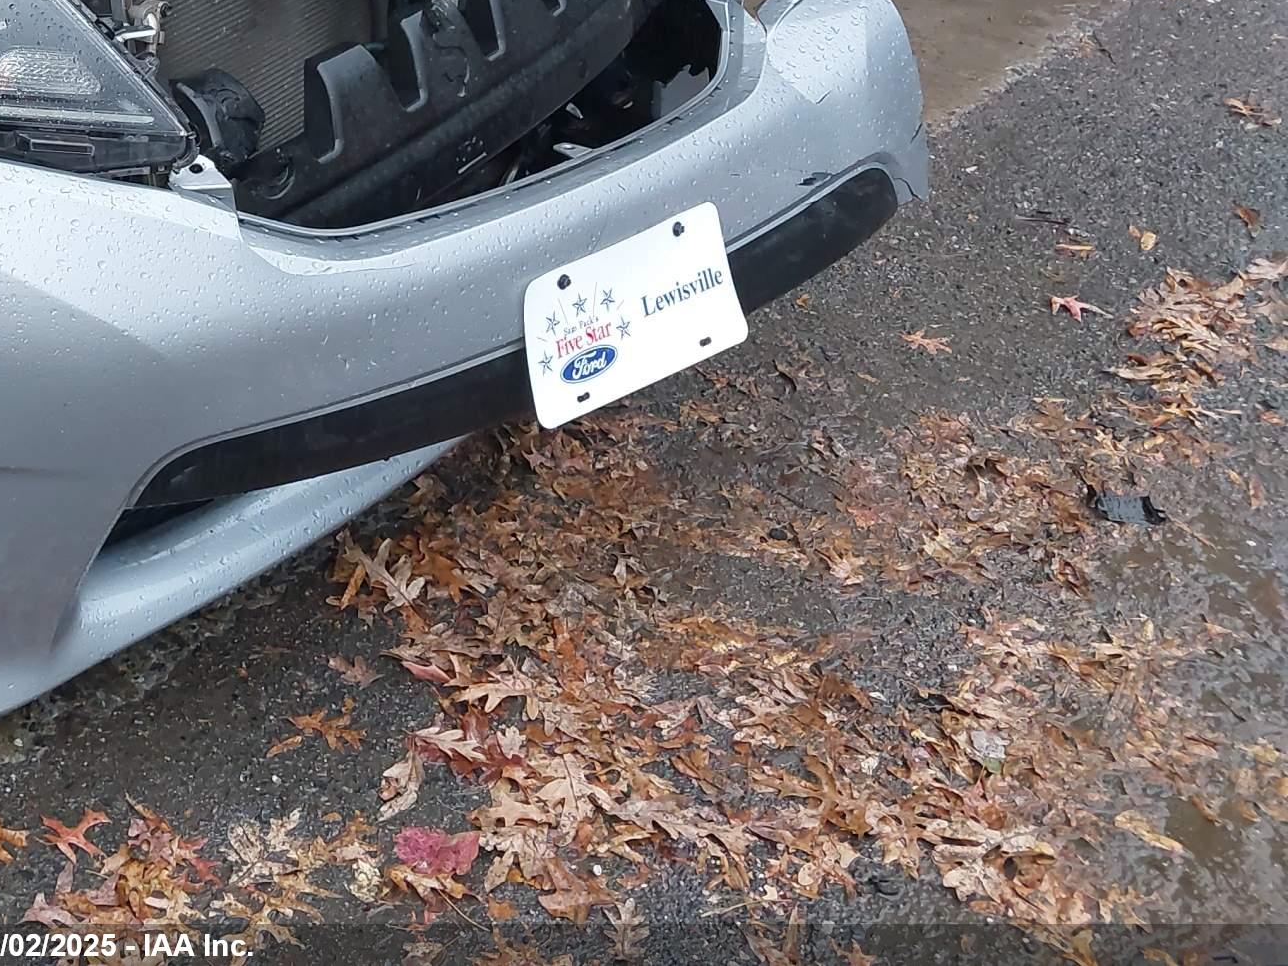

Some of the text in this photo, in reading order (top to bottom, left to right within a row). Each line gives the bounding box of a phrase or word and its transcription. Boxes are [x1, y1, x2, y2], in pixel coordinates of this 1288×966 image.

[641, 267, 724, 317] Lewisville
[555, 321, 612, 359] Five Star
[572, 349, 609, 380] Ford
